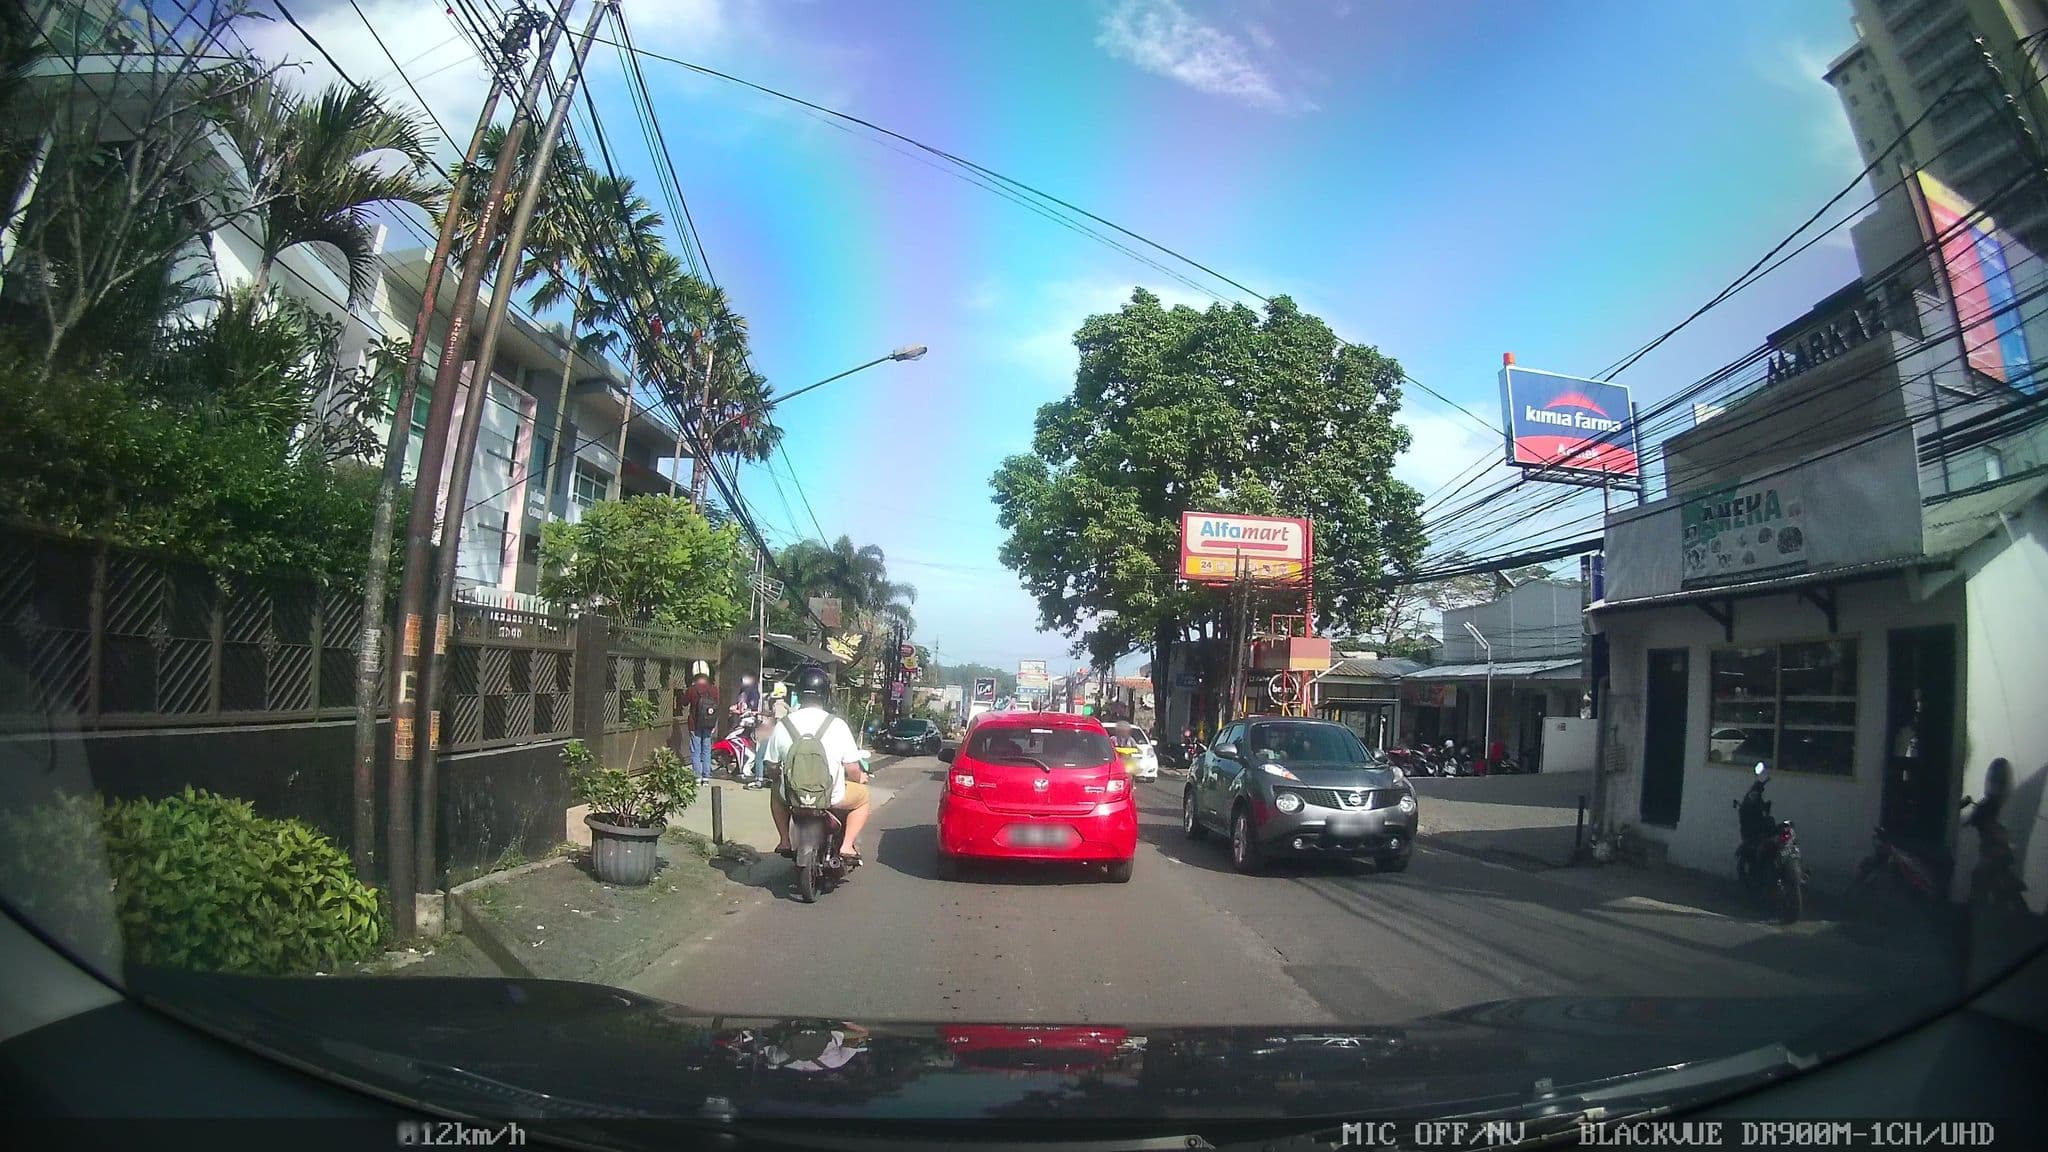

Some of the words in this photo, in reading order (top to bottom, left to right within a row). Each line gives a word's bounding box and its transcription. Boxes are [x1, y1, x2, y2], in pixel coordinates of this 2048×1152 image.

[1525, 405, 1572, 427] kimia
[1574, 411, 1622, 432] farma
[1556, 443, 1601, 459] Atek
[1200, 520, 1289, 541] Alfamart
[1201, 561, 1212, 569] 24
